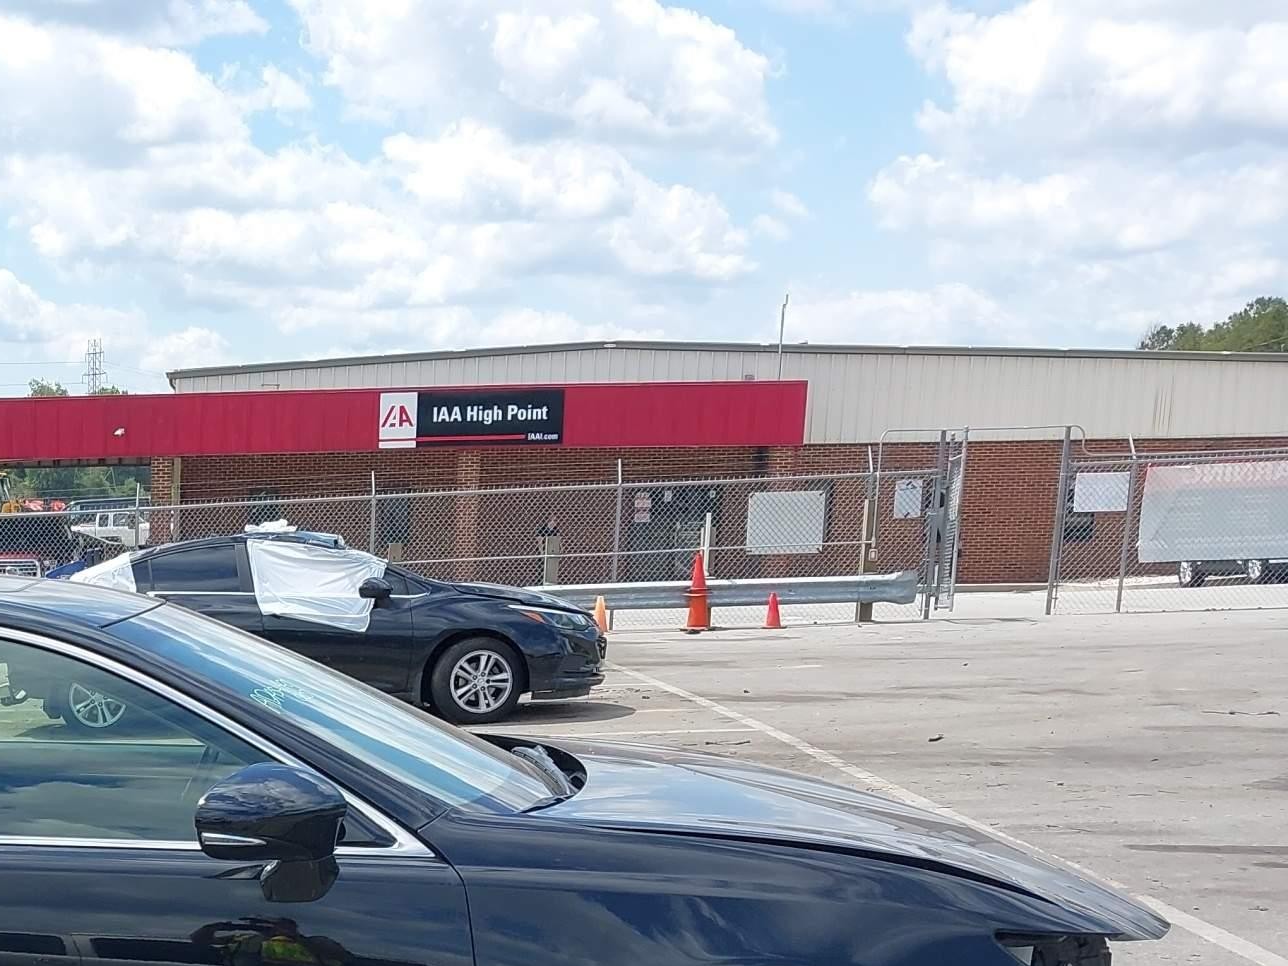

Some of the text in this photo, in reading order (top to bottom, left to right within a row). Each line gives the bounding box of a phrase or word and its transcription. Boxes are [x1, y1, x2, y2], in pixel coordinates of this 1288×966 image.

[432, 404, 549, 425] IAA High Point
